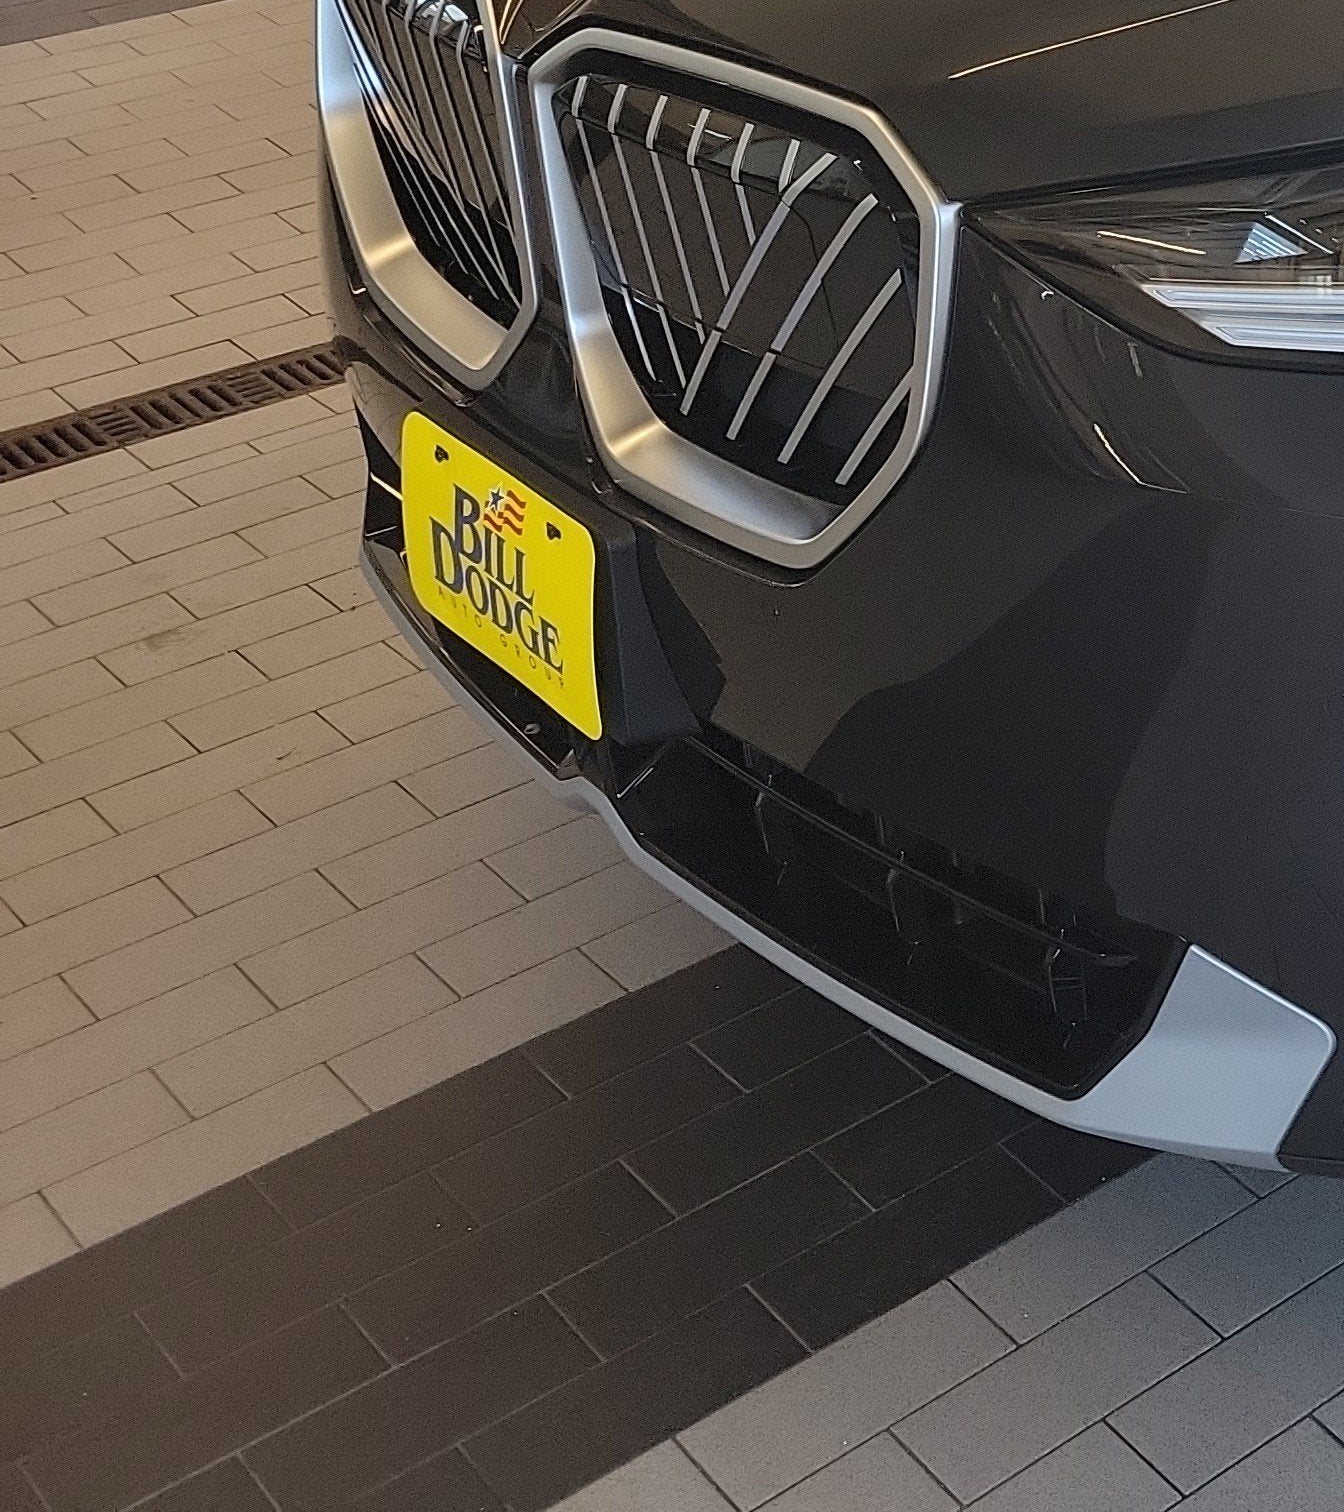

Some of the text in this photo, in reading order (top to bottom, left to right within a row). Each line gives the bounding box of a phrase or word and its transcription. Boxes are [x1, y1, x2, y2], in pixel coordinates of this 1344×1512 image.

[429, 515, 564, 675] DODGE
[452, 482, 535, 607] BILL
[438, 585, 565, 689] AUTO GROUP
